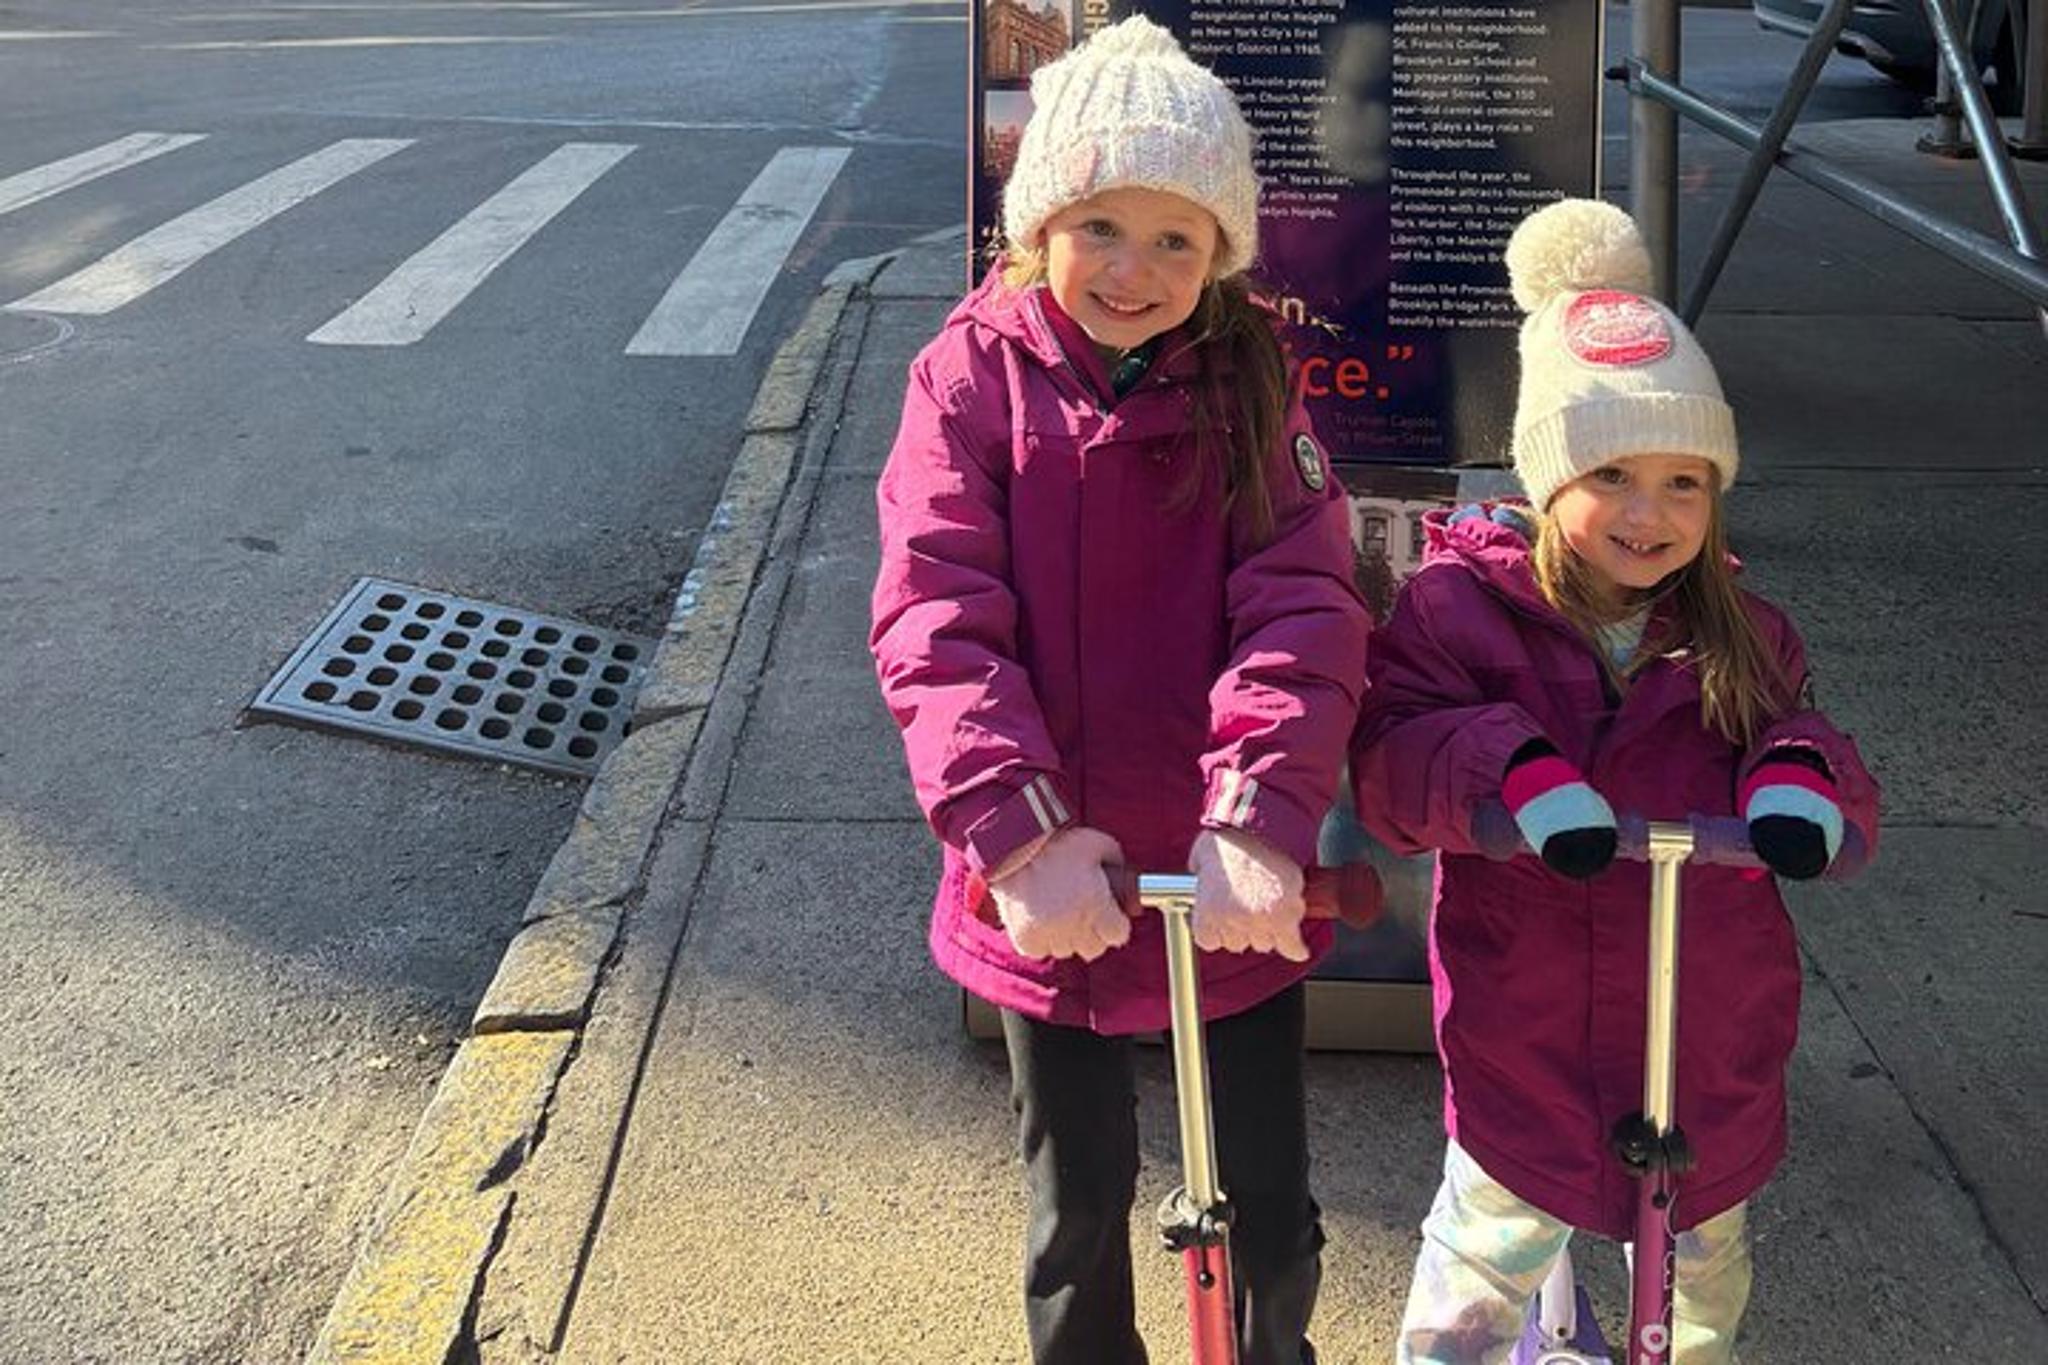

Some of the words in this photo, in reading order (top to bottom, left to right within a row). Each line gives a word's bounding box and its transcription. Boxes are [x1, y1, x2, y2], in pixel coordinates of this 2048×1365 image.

[1190, 11, 1254, 23] designation
[1258, 11, 1269, 21] of
[1272, 11, 1289, 21] the
[1294, 11, 1336, 25] Heights
[1393, 6, 1439, 17] cultural
[1442, 7, 1506, 18] institutions
[1509, 8, 1537, 18] have
[1206, 27, 1231, 37] New
[1234, 27, 1258, 37] York
[1261, 27, 1291, 40] City's
[1294, 28, 1317, 39] first
[1393, 23, 1428, 33] added
[1430, 23, 1442, 33] to
[1445, 23, 1463, 33] the
[1190, 42, 1234, 53] Historic
[1237, 43, 1277, 54] District
[1280, 44, 1292, 54] in
[1393, 38, 1408, 48] St.
[1411, 39, 1454, 49] Francis
[1393, 55, 1444, 68] Brooklyn
[1447, 56, 1471, 66] Law
[1473, 56, 1511, 66] School
[1514, 57, 1536, 67] and
[1243, 77, 1285, 87] Lincoln
[1288, 78, 1326, 90] prayed
[1392, 72, 1411, 84] top
[1413, 73, 1480, 85] preparatory
[1260, 92, 1300, 103] Church
[1302, 94, 1337, 103] where
[1393, 88, 1448, 100] Montague
[1452, 89, 1491, 100] Street,
[1493, 90, 1511, 99] the
[1254, 109, 1288, 121] Henry
[1291, 110, 1320, 120] Ward
[1391, 105, 1440, 117] year-old
[1443, 106, 1483, 116] central
[1487, 107, 1554, 117] commercial
[1294, 125, 1310, 136] for
[1391, 121, 1428, 132] street,
[1431, 121, 1462, 134] plays
[1475, 122, 1494, 134] key
[1497, 123, 1520, 132] role
[1523, 123, 1533, 133] in
[1269, 142, 1287, 152] the
[1391, 138, 1413, 147] this
[1269, 158, 1310, 170] printed
[1314, 158, 1329, 169] his
[1289, 174, 1320, 185] Years
[1323, 175, 1354, 187] later,
[1390, 168, 1457, 182] Throughout
[1459, 170, 1477, 181] the
[1480, 172, 1510, 183] year,
[1512, 172, 1531, 182] the
[1268, 190, 1305, 201] artists
[1308, 191, 1338, 201] came
[1390, 185, 1456, 197] Promenade
[1459, 186, 1503, 198] attracts
[1506, 188, 1565, 199] thousands
[1390, 202, 1402, 212] of
[1405, 202, 1446, 213] visitors
[1449, 203, 1474, 214] with
[1476, 204, 1491, 214] its
[1493, 205, 1519, 214] view
[1521, 205, 1534, 214] of
[1390, 218, 1415, 229] York
[1418, 218, 1463, 231] Harbor,
[1464, 219, 1483, 230] the
[1390, 234, 1434, 247] Liberty,
[1436, 235, 1454, 246] the
[1390, 252, 1411, 261] and
[1413, 252, 1431, 262] the
[1435, 252, 1485, 264] Brooklyn
[1389, 282, 1436, 294] Beneath
[1439, 283, 1457, 294] the
[1389, 299, 1440, 311] Brooklyn
[1442, 299, 1480, 313] Bridge
[1482, 301, 1509, 312] Park
[1388, 315, 1434, 328] beautify
[1436, 316, 1454, 327] the
